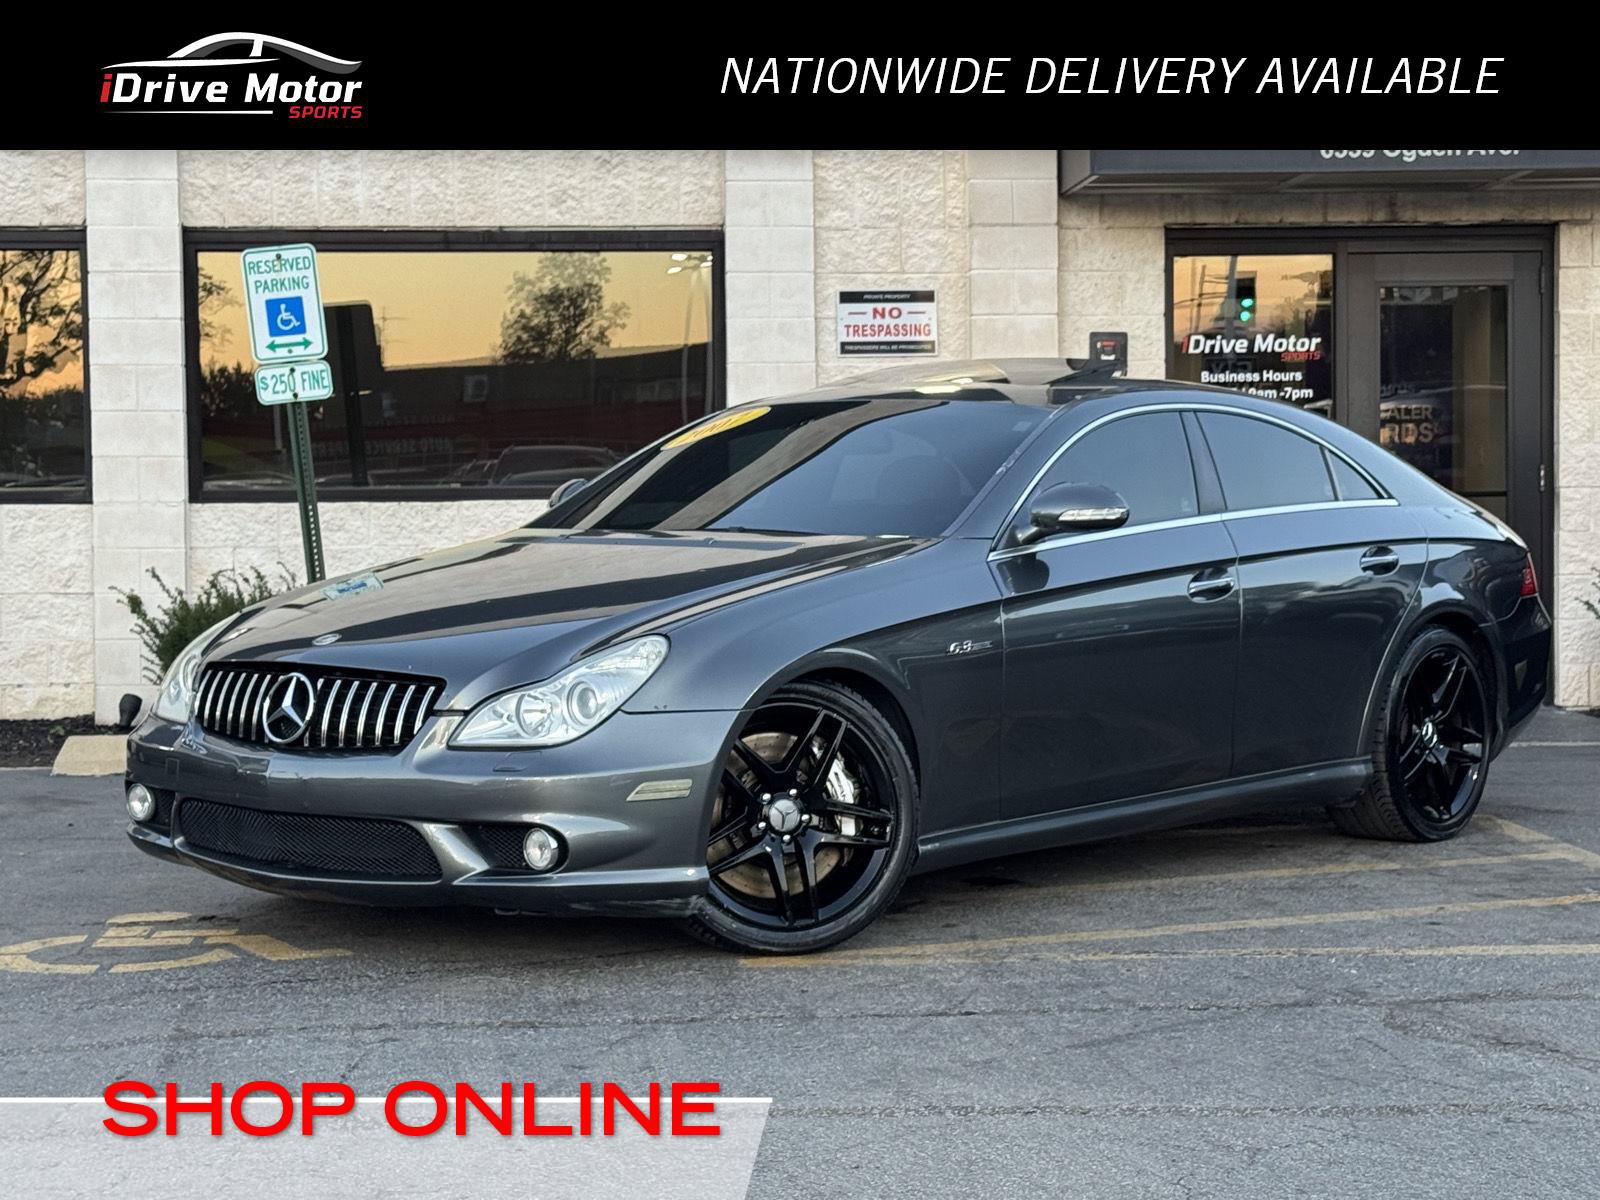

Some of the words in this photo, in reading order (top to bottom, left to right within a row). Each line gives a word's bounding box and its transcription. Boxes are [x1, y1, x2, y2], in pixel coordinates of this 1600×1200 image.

[248, 256, 312, 276] RESERVED
[254, 275, 310, 294] PARKING
[872, 307, 902, 319] NO
[844, 324, 931, 338] TRESPASSING
[1254, 333, 1322, 353] Motor
[259, 373, 296, 395] $250
[300, 369, 329, 391] FINE
[1201, 370, 1260, 383] Business
[1263, 369, 1303, 382] Hours
